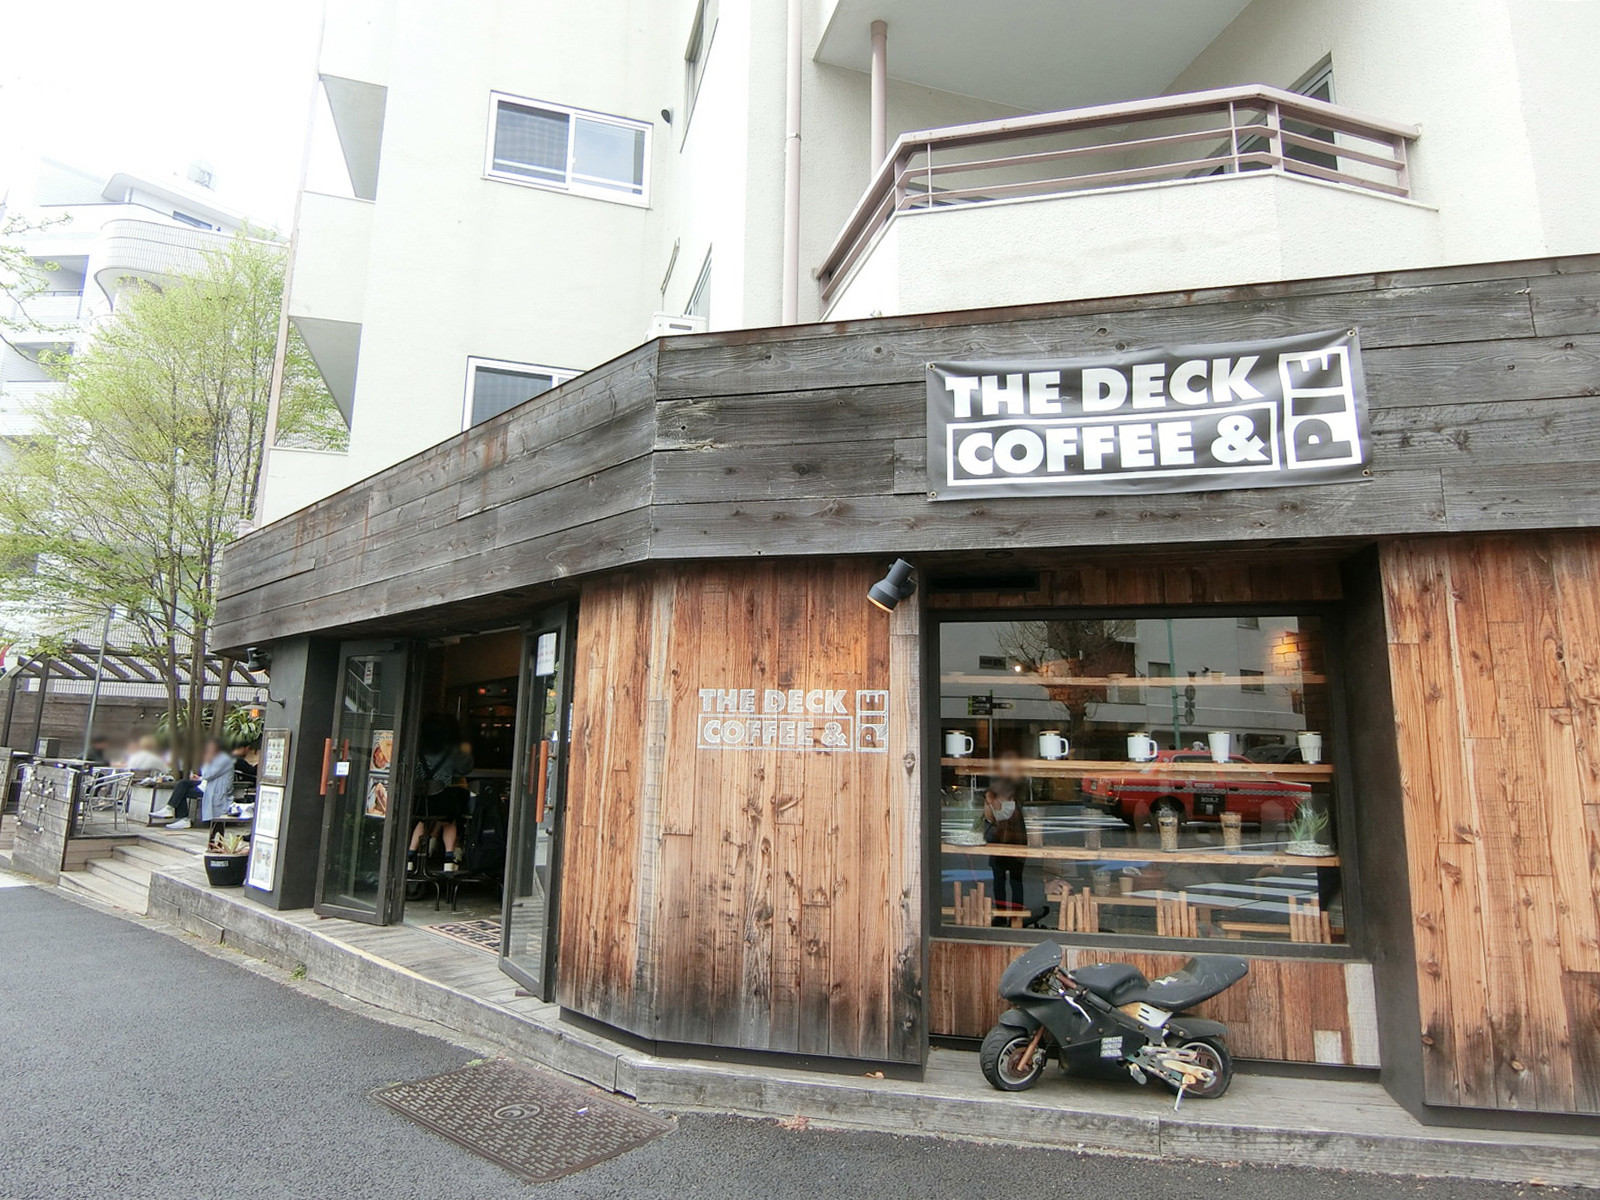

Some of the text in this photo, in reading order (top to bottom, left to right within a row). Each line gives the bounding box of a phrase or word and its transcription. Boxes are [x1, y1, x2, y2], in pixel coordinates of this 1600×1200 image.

[945, 355, 1265, 418] THE DECK
[1286, 350, 1352, 463] PIE
[957, 414, 1271, 476] COFFEE &
[698, 688, 848, 713] THE DECK
[859, 692, 886, 748] PIE
[703, 719, 849, 747] COFFEE &
